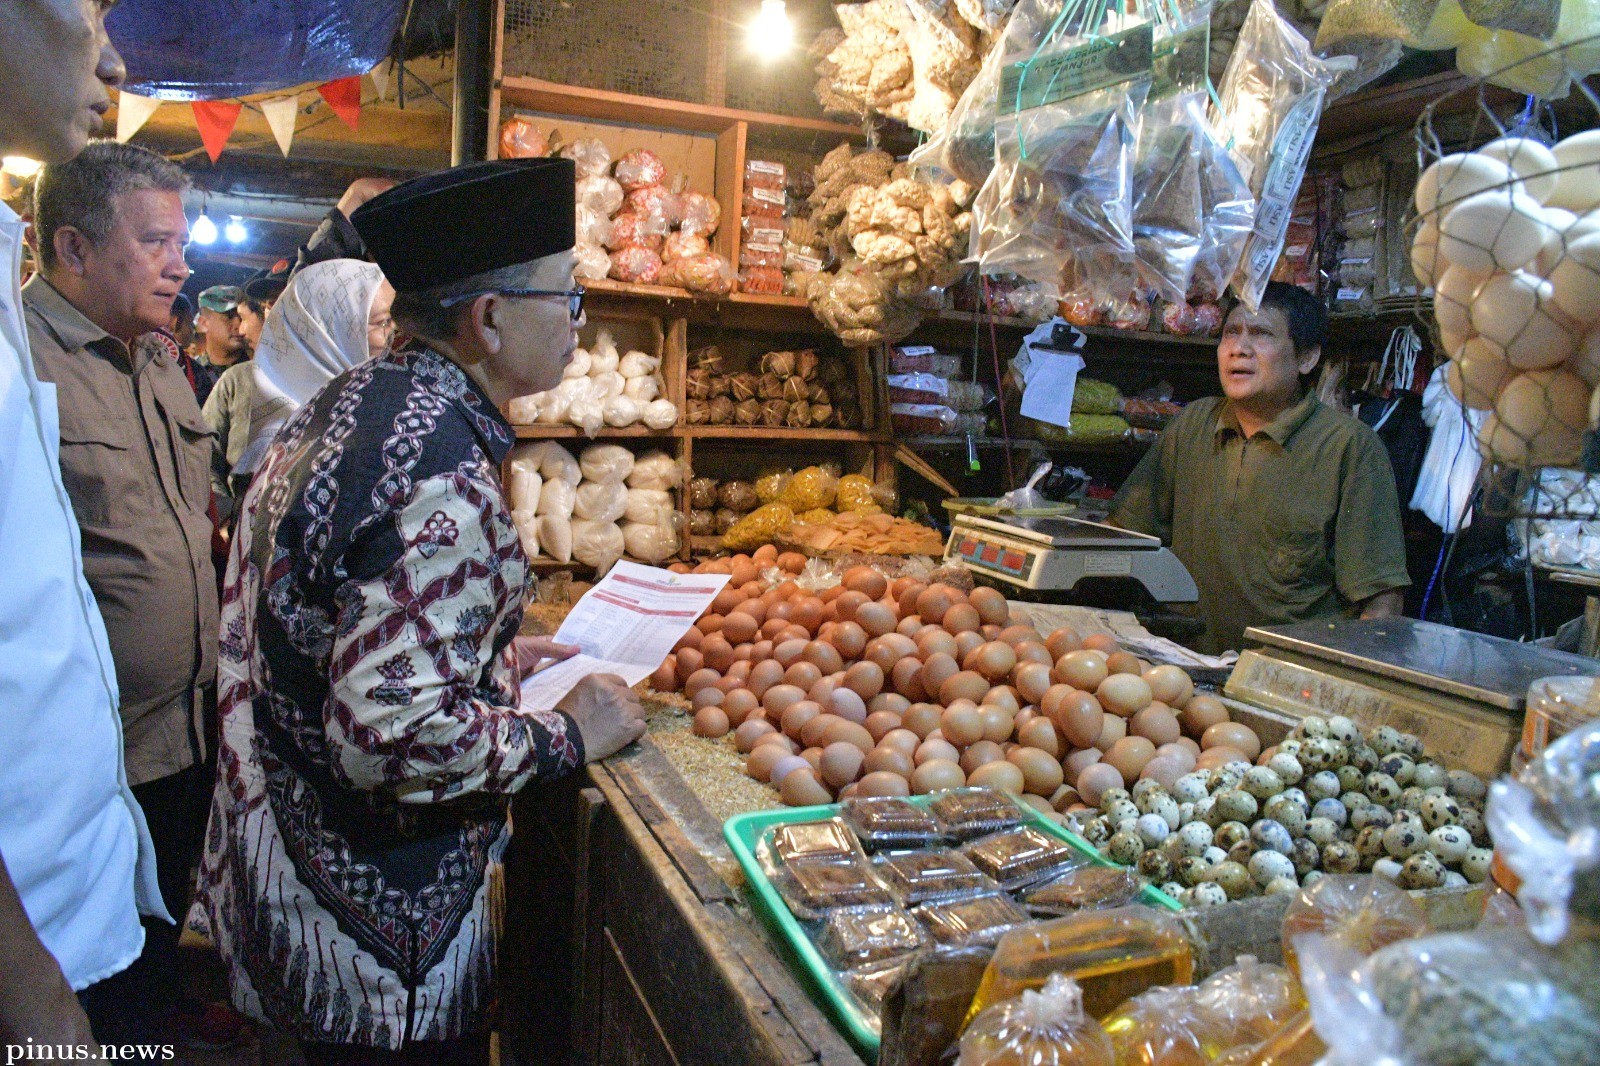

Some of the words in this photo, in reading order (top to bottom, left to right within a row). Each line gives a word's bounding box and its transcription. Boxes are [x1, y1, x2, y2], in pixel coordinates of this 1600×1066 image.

[1283, 168, 1296, 190] ASLI
[1269, 205, 1283, 226] ASLI
[1254, 251, 1269, 272] ASLI
